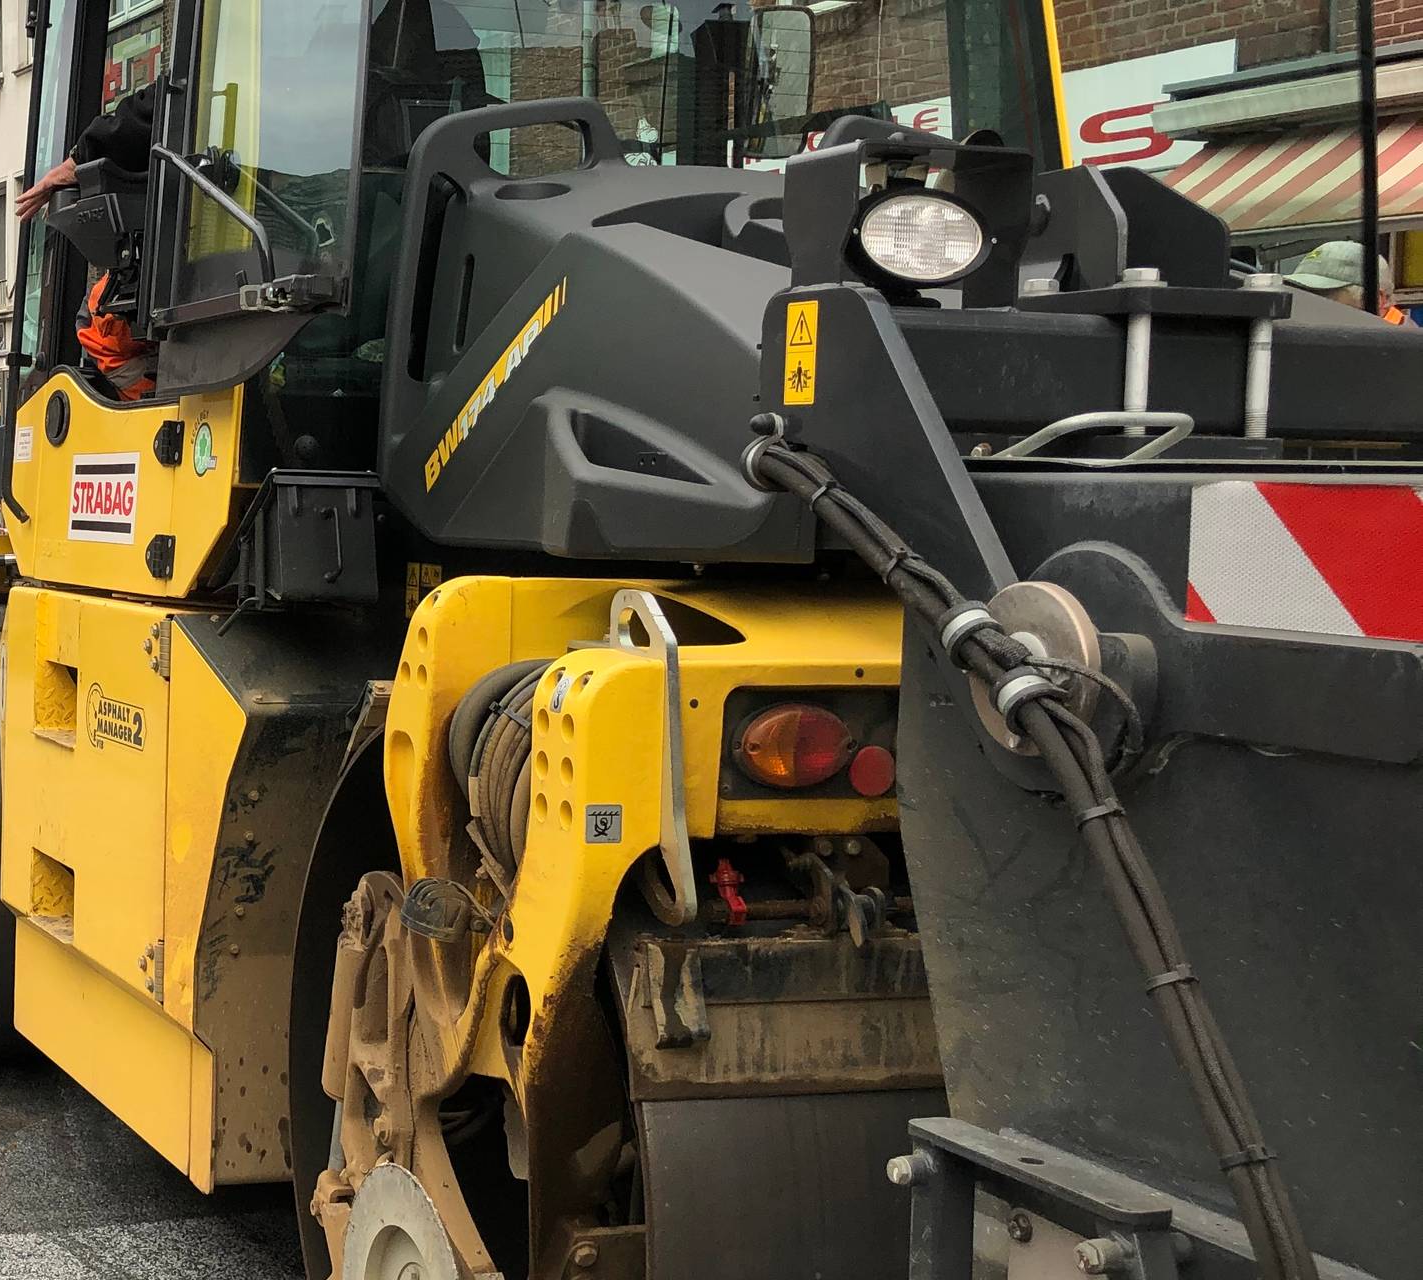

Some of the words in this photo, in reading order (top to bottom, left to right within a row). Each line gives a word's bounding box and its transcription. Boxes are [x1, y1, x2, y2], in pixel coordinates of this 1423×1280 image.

[72, 481, 134, 516] STRABAG
[97, 718, 133, 743] MANAGER
[133, 711, 143, 747] 2
[98, 700, 130, 723] ASPHALT
